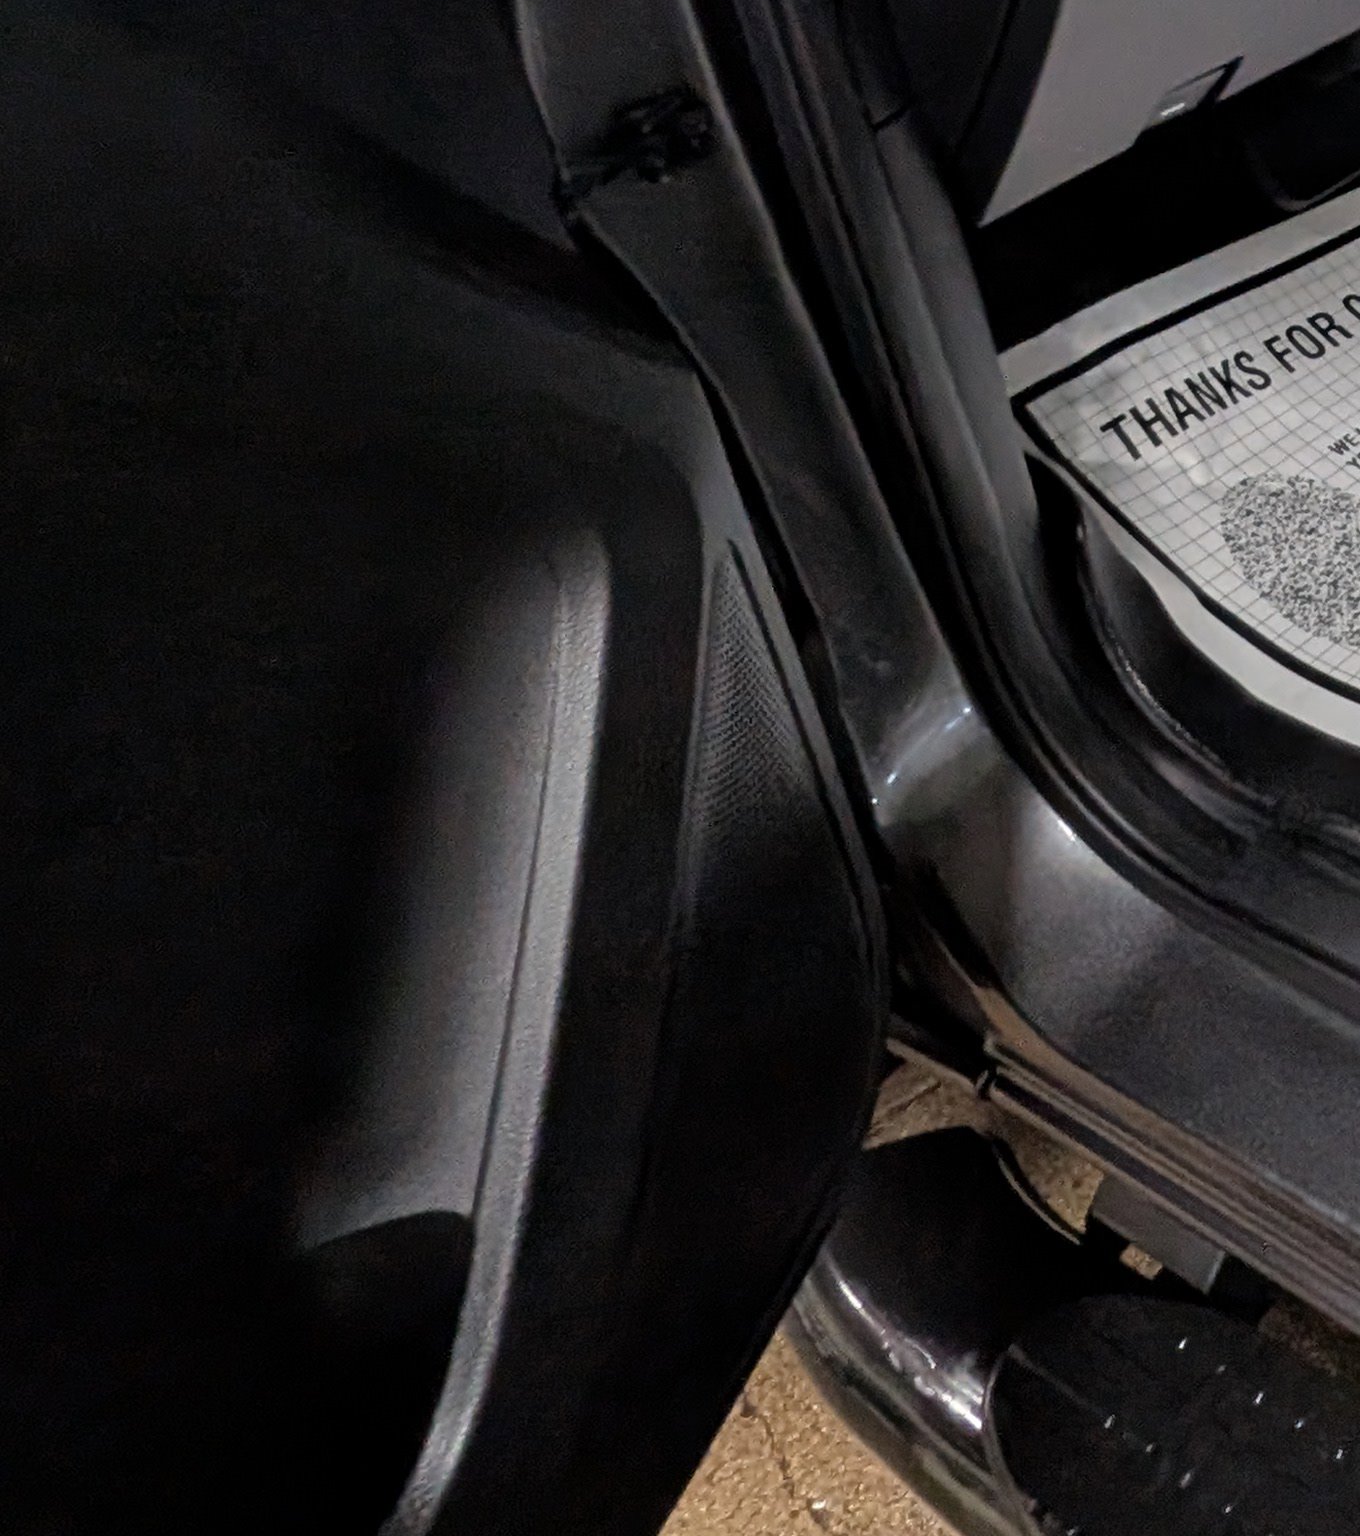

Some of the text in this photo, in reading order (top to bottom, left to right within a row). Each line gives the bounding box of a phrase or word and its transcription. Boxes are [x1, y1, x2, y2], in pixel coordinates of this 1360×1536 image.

[1100, 350, 1271, 461] THANKS
[1264, 312, 1353, 372] FOR
[1328, 434, 1360, 456] WE
